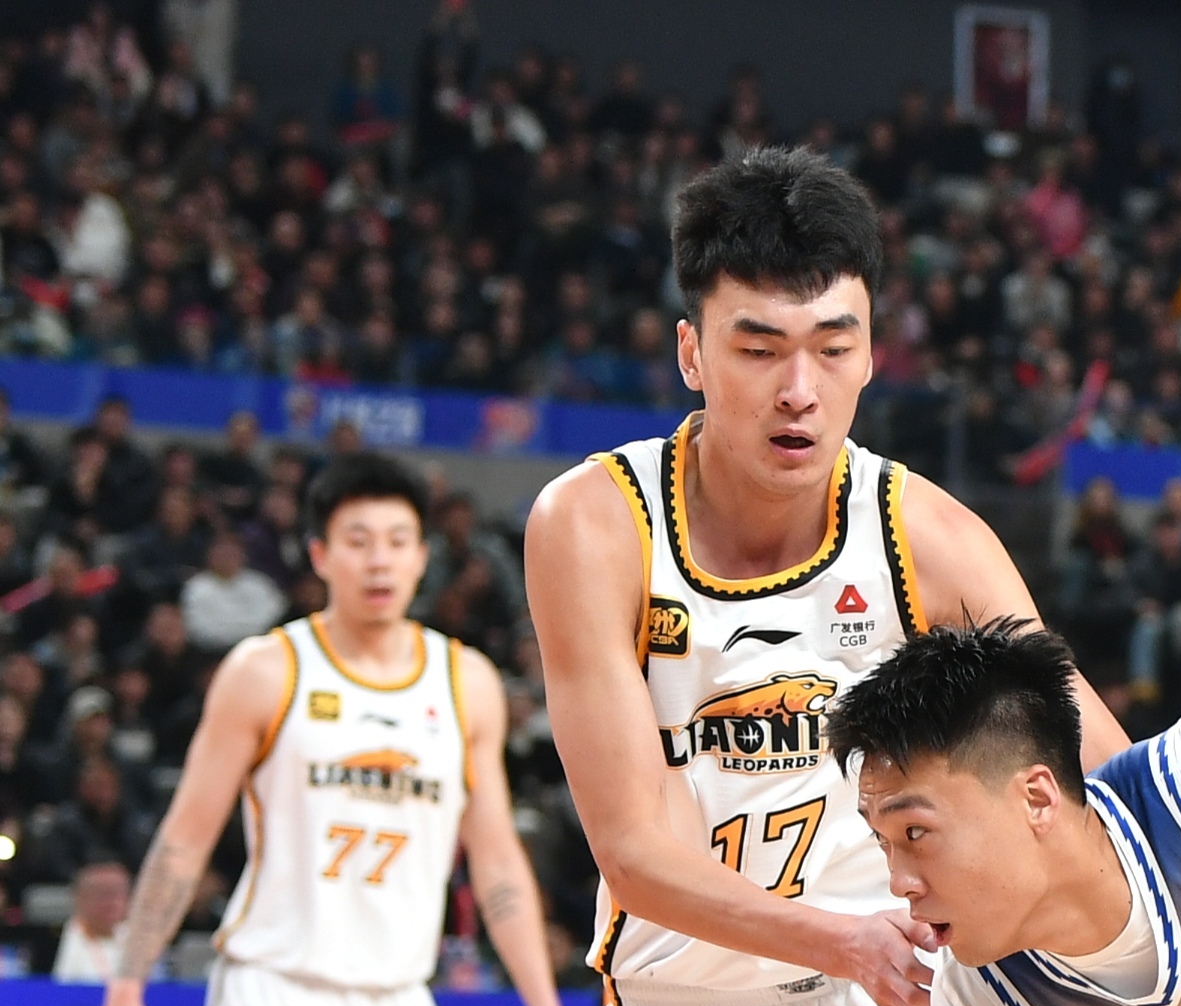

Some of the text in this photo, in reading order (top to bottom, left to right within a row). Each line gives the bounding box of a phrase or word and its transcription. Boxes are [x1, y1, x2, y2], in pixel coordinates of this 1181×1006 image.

[830, 620, 876, 633] 广发银行
[839, 634, 867, 647] CGB
[660, 713, 821, 768] LIAONI
[722, 754, 819, 772] LEOPARDS
[322, 825, 408, 885] 77
[711, 794, 828, 898] 17
